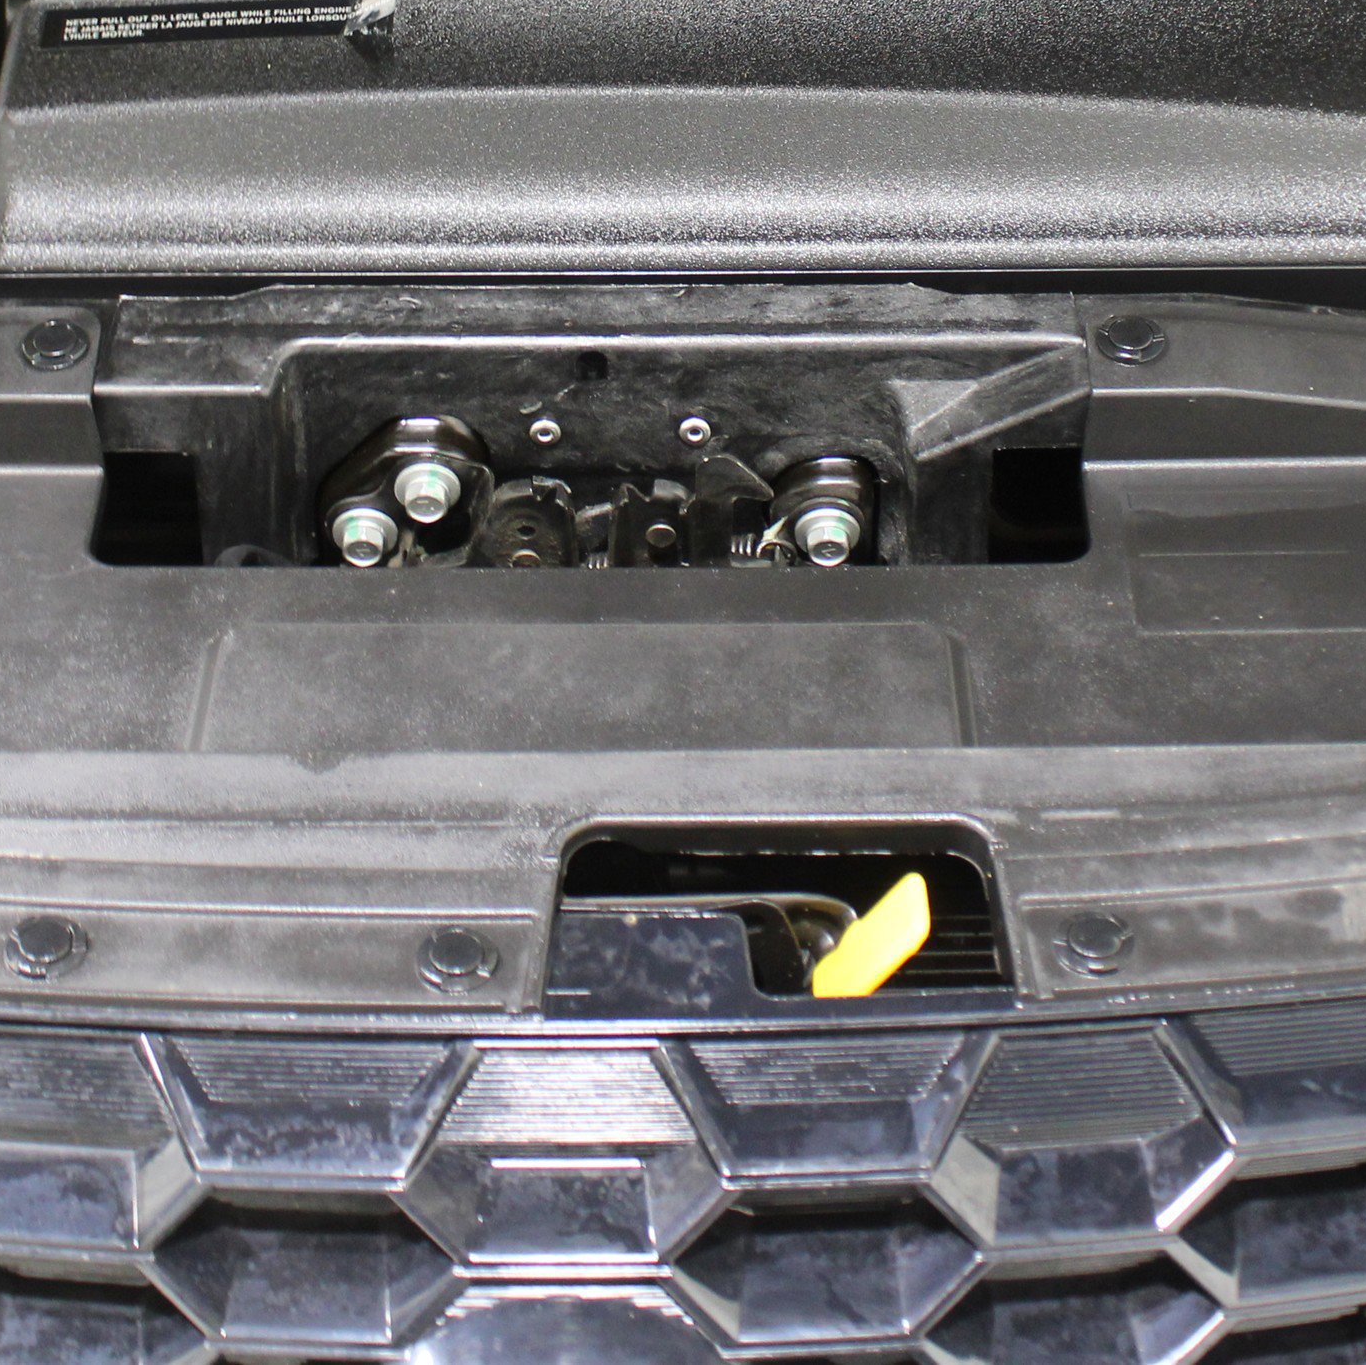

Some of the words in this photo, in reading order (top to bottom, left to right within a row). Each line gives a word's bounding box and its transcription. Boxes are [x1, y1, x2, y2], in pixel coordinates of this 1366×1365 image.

[64, 26, 77, 34] NE
[80, 25, 115, 33] JAMAIS
[118, 23, 158, 31] RETIRER
[161, 22, 173, 30] LA
[175, 20, 207, 29] JAUGE
[209, 19, 223, 27] DE
[226, 18, 262, 26] NIVEAU
[264, 16, 303, 25] D'HUILE
[66, 18, 98, 26] NEVER
[101, 17, 125, 25] PULL
[127, 15, 149, 23] OUT
[151, 14, 167, 22] OIL
[170, 13, 199, 21] LEVEL
[202, 11, 237, 20] GAUGE
[240, 10, 271, 18] WHILE
[273, 8, 311, 16] FILLING
[313, 7, 352, 15] ENGINE
[63, 31, 99, 41] L'HUILE
[101, 29, 144, 38] MOTEUR.
